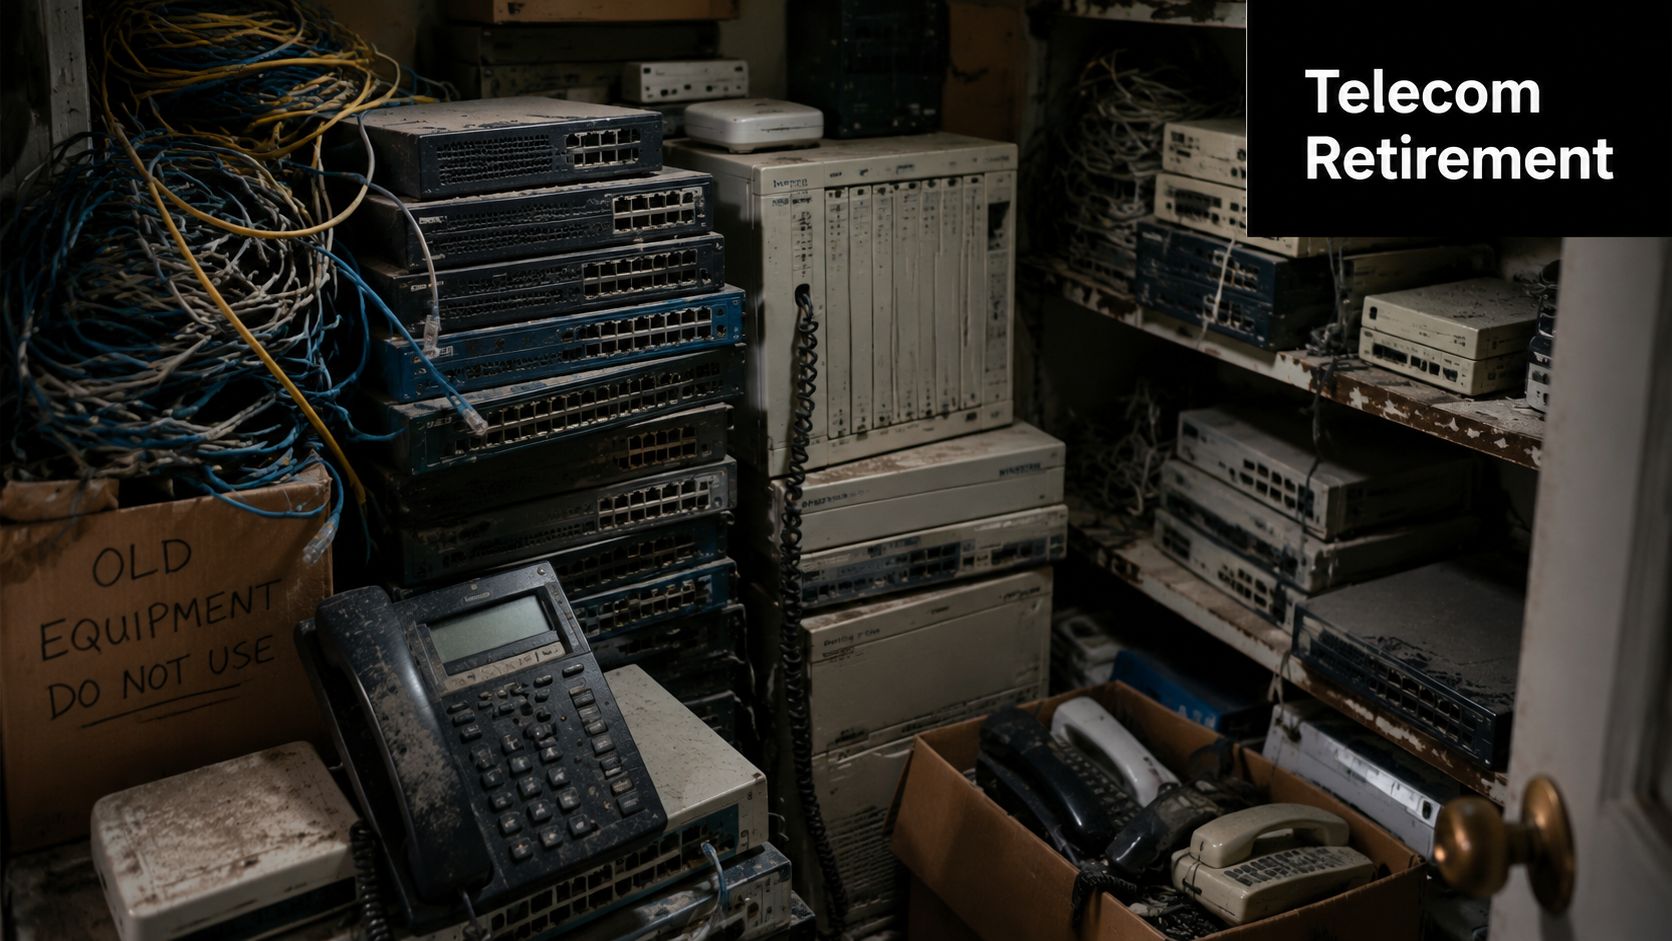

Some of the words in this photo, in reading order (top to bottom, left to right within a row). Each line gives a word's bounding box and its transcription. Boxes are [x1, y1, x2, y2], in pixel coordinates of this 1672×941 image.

[91, 538, 192, 588] OLD
[39, 577, 283, 662] EQUIPMENT
[47, 679, 101, 721] DO
[122, 653, 191, 700] NOT
[208, 634, 275, 676] USE
